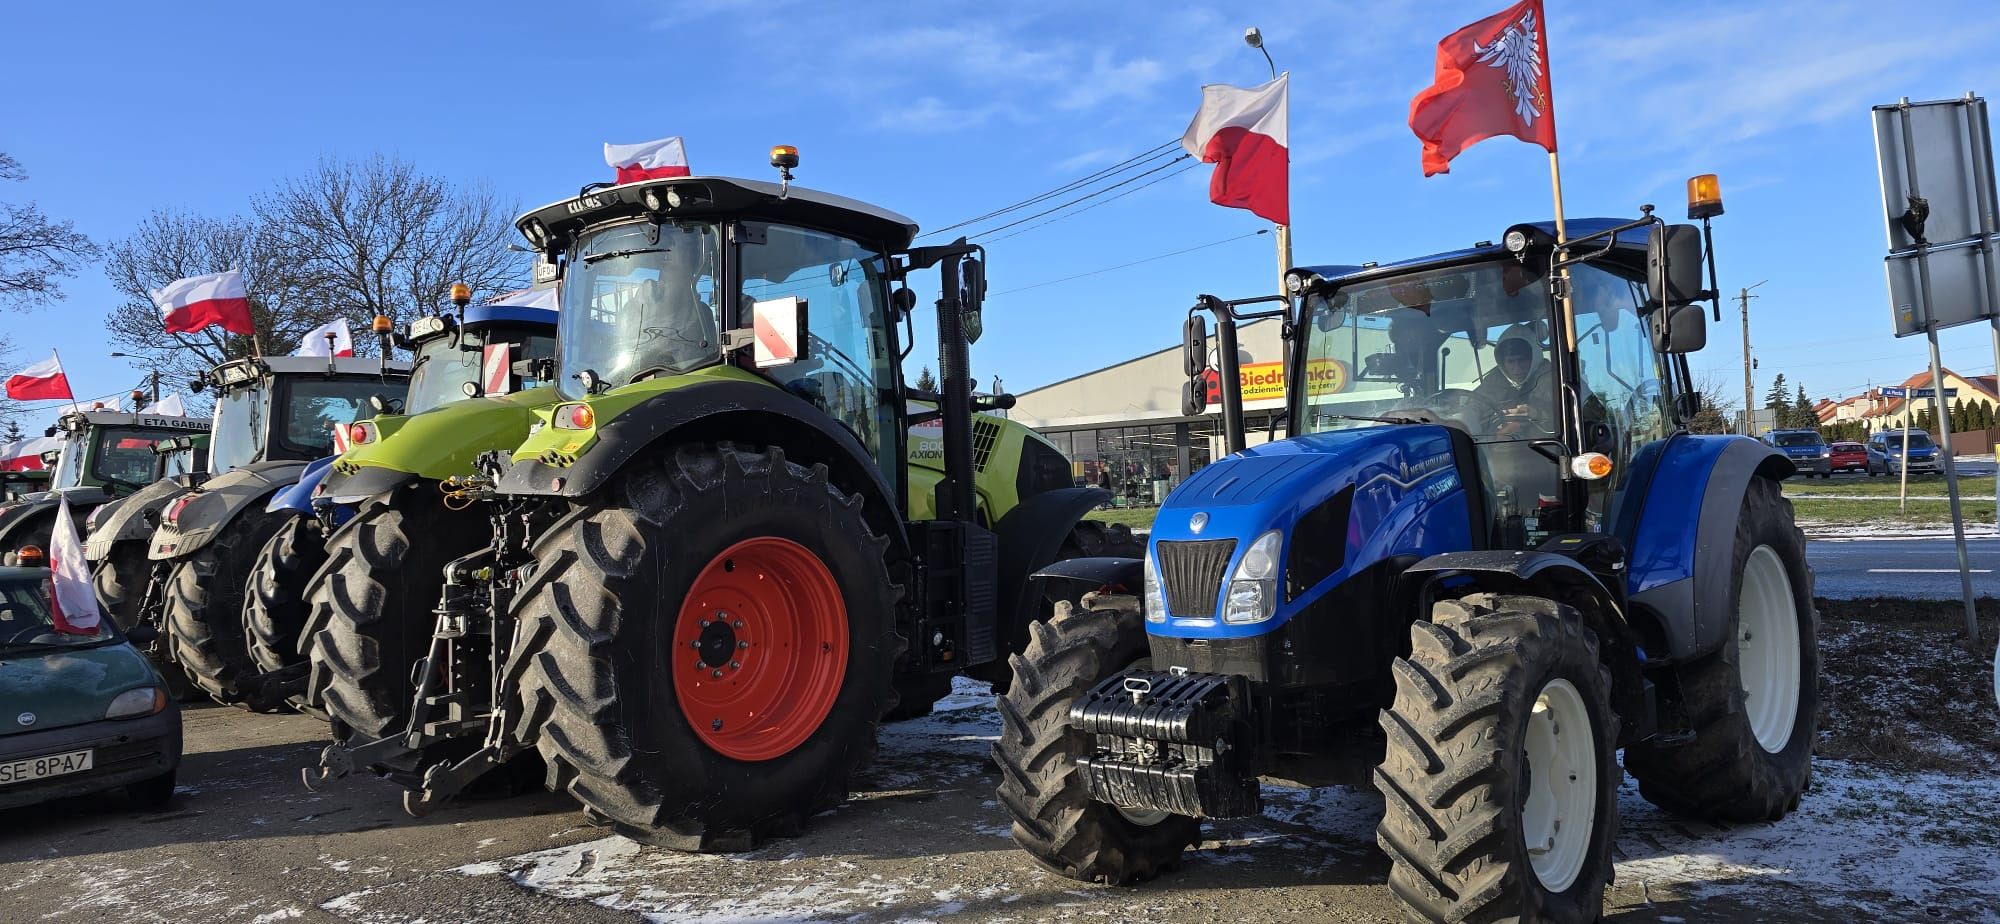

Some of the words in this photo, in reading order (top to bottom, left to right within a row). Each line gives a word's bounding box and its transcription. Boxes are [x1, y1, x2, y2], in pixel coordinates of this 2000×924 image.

[1240, 367, 1335, 386] Biedrnka
[171, 420, 212, 430] GABAR
[910, 450, 943, 459] AXION
